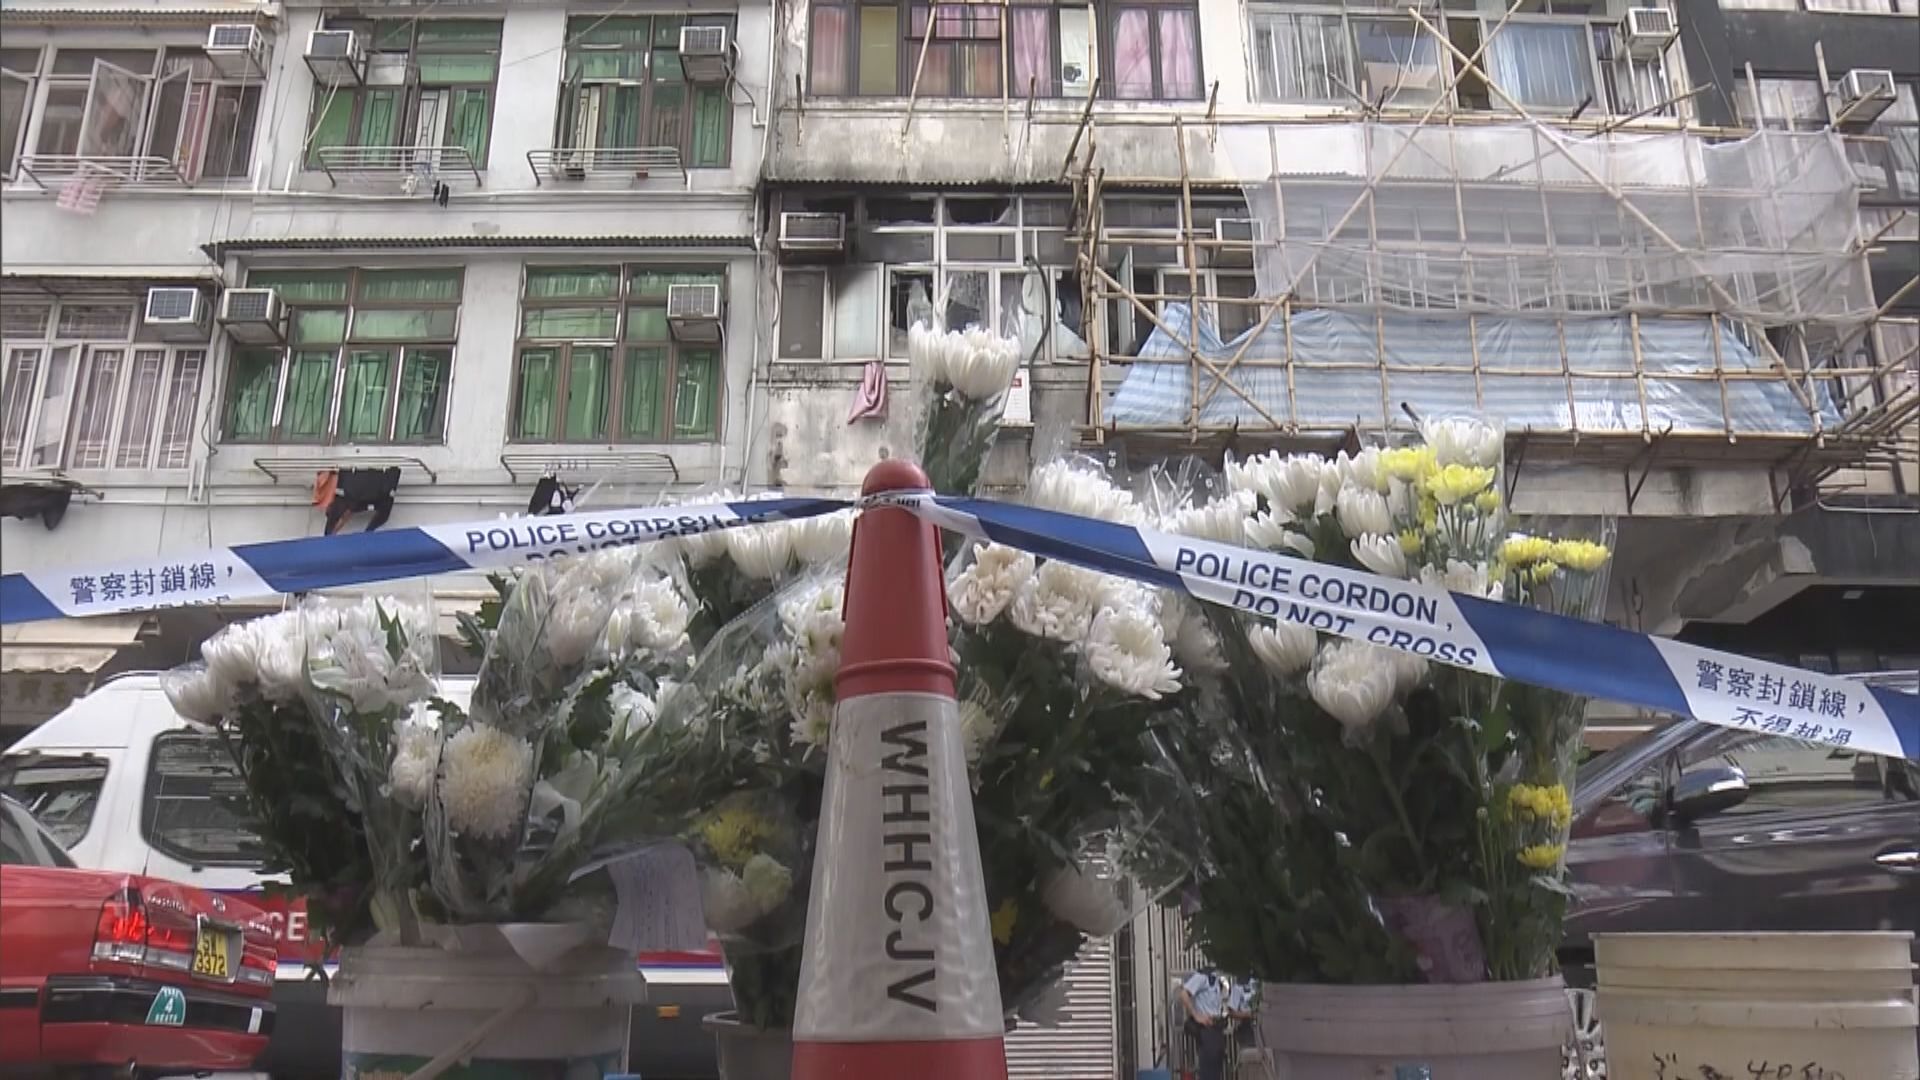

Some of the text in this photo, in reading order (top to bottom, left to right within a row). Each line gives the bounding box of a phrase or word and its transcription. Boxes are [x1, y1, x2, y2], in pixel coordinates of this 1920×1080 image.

[466, 523, 578, 553] POLICE
[1175, 547, 1292, 593] POLICE
[1367, 625, 1478, 667] CROSS
[880, 720, 937, 1013] WHHCJV
[194, 951, 227, 976] 3372
[164, 997, 174, 1013] 4
